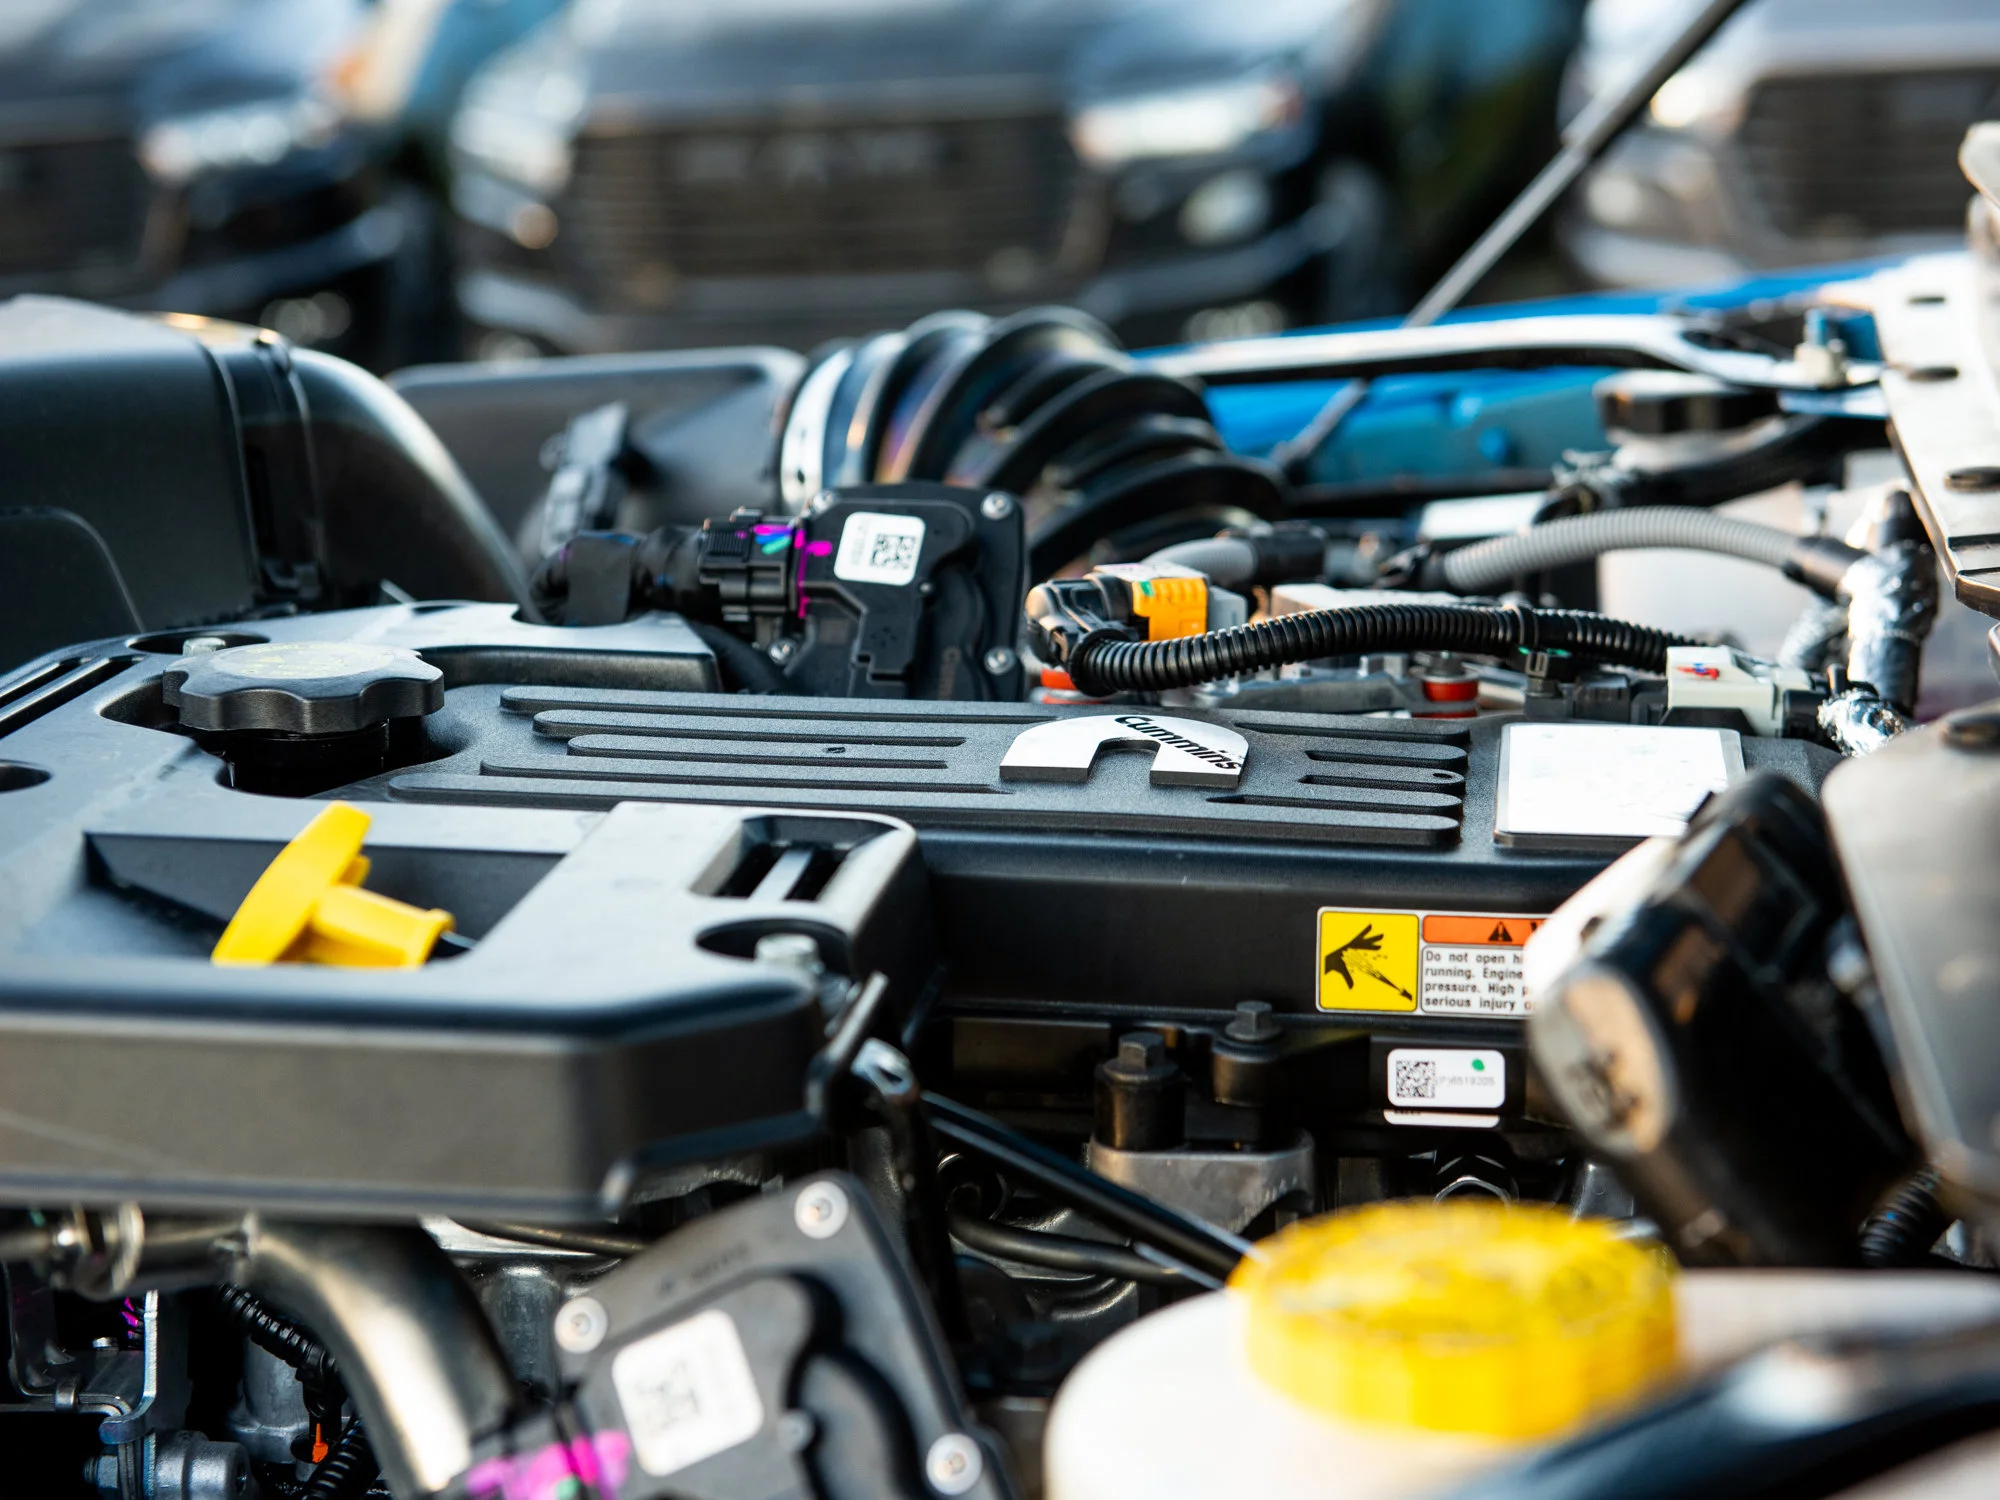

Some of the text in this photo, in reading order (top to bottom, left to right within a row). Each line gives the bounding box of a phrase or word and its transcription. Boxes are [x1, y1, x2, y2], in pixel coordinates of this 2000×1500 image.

[1114, 715, 1242, 770] Cummins
[1425, 951, 1441, 962] Do
[1449, 952, 1468, 962] not
[1476, 954, 1506, 964] open
[1425, 967, 1523, 980] running. Engine
[1425, 982, 1481, 993] pressure.
[1488, 983, 1515, 996] High
[1425, 997, 1472, 1007] serious
[1480, 998, 1516, 1011] injury
